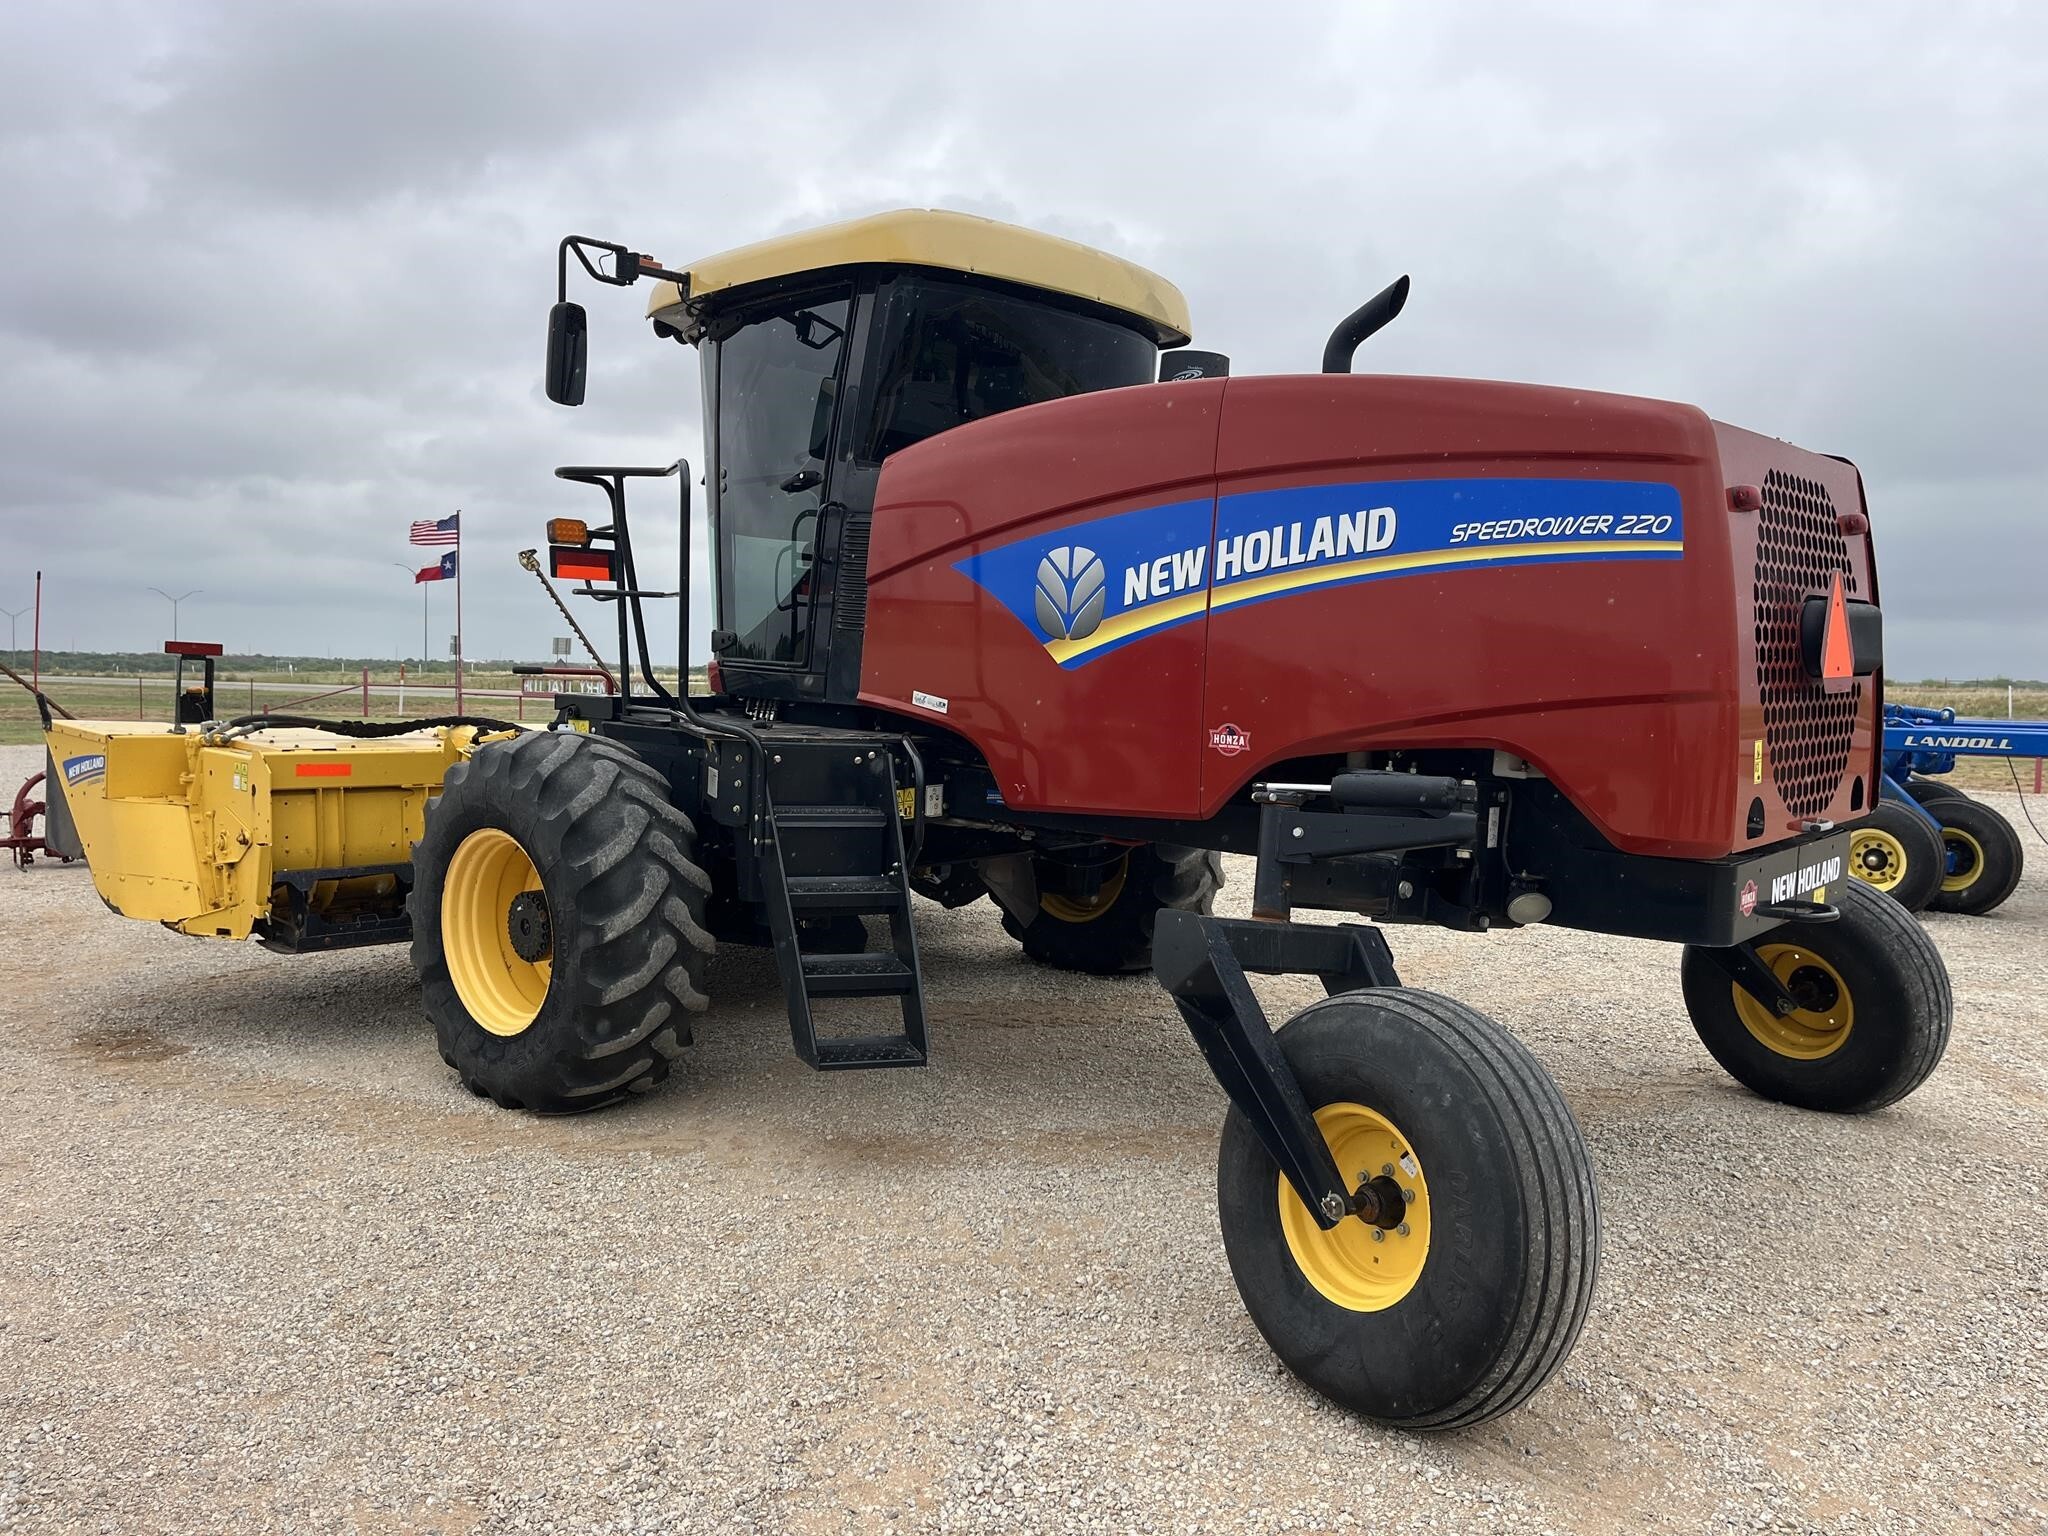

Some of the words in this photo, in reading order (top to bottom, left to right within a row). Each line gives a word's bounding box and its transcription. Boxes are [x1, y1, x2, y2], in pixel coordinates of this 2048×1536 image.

[1449, 515, 1614, 543] SPEEDROWER
[1615, 515, 1673, 535] 220
[1123, 545, 1207, 607] NEW
[1215, 506, 1398, 581] HOLLAND
[1213, 733, 1245, 746] HONZA
[1904, 735, 2013, 750] LANDOLL
[68, 762, 81, 779] NEW
[1771, 871, 1797, 905] NEW
[1797, 856, 1841, 895] HOLLAND
